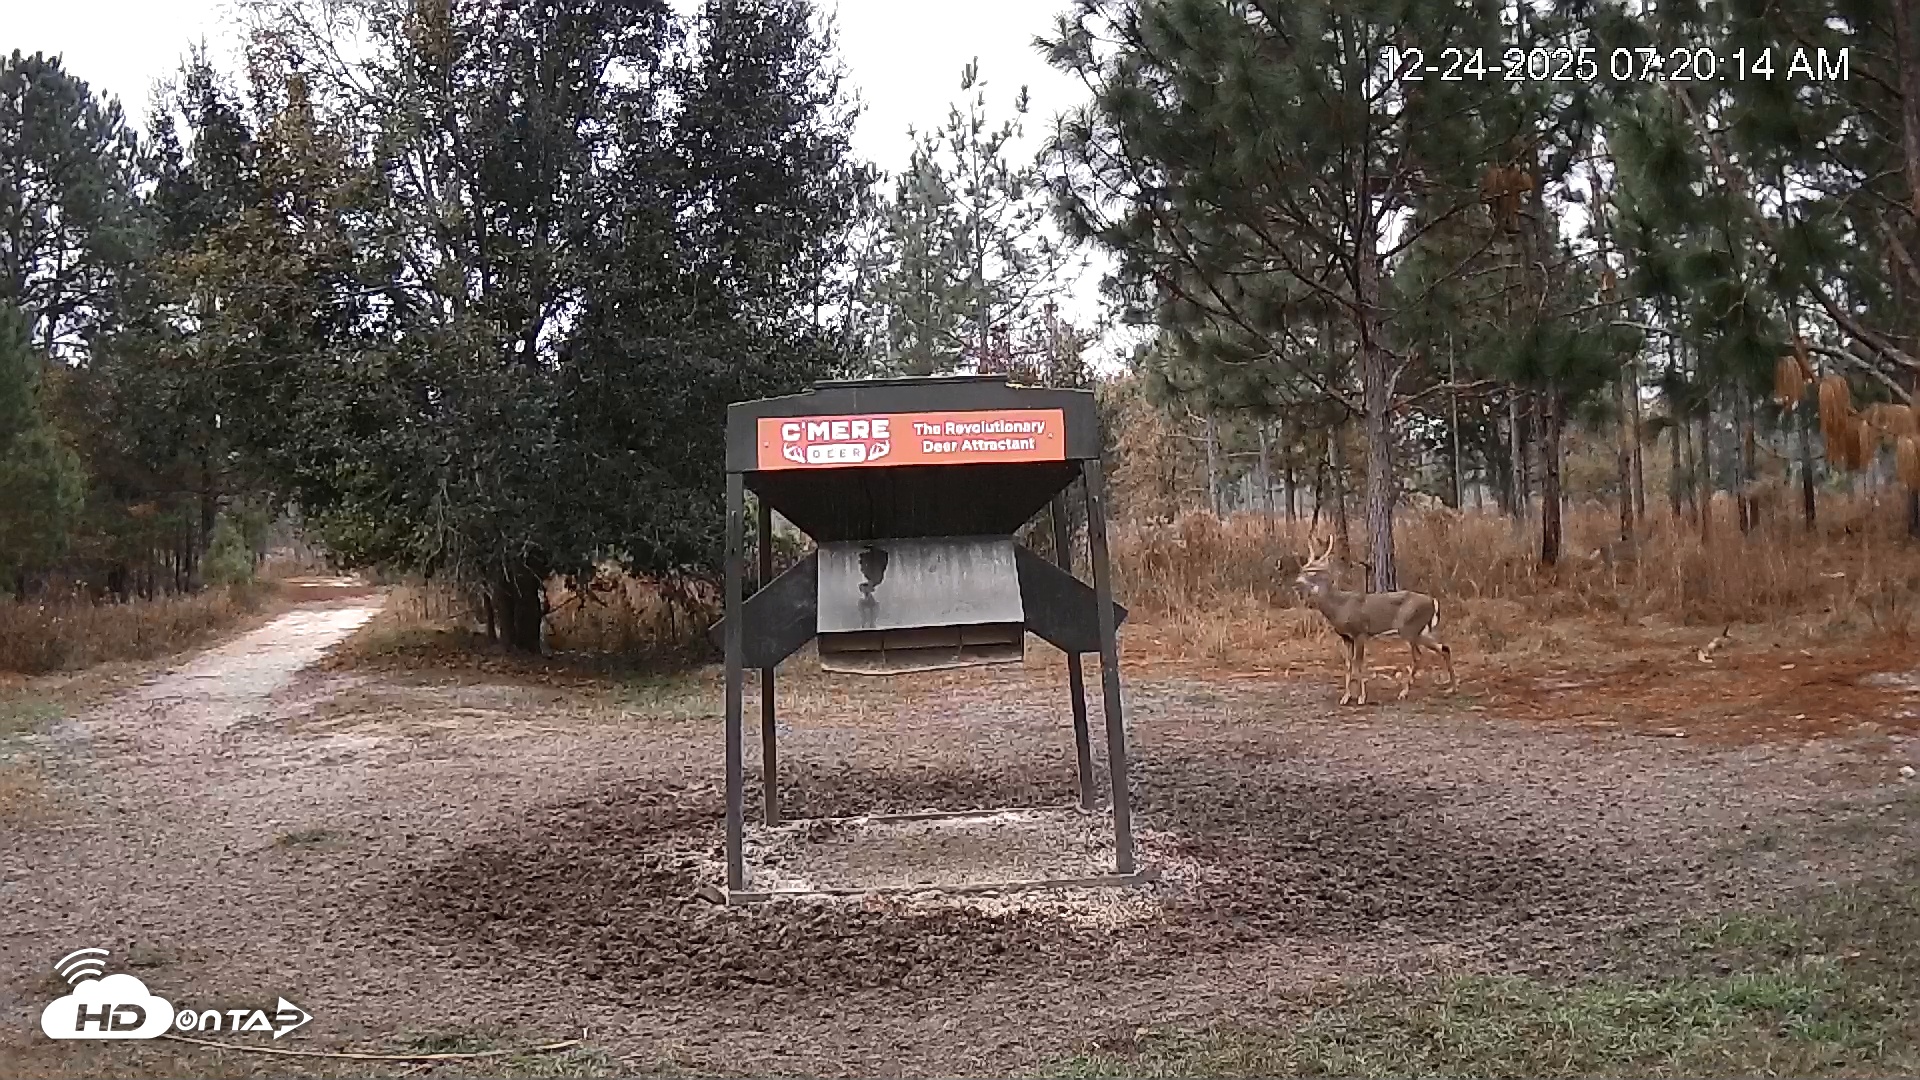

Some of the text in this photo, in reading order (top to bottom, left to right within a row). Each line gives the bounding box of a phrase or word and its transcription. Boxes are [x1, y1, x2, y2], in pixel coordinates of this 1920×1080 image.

[781, 419, 890, 442] C'MERE
[914, 420, 1046, 436] The Revolutionary
[811, 447, 861, 459] DEER
[922, 437, 1035, 454] Deer Attractant
